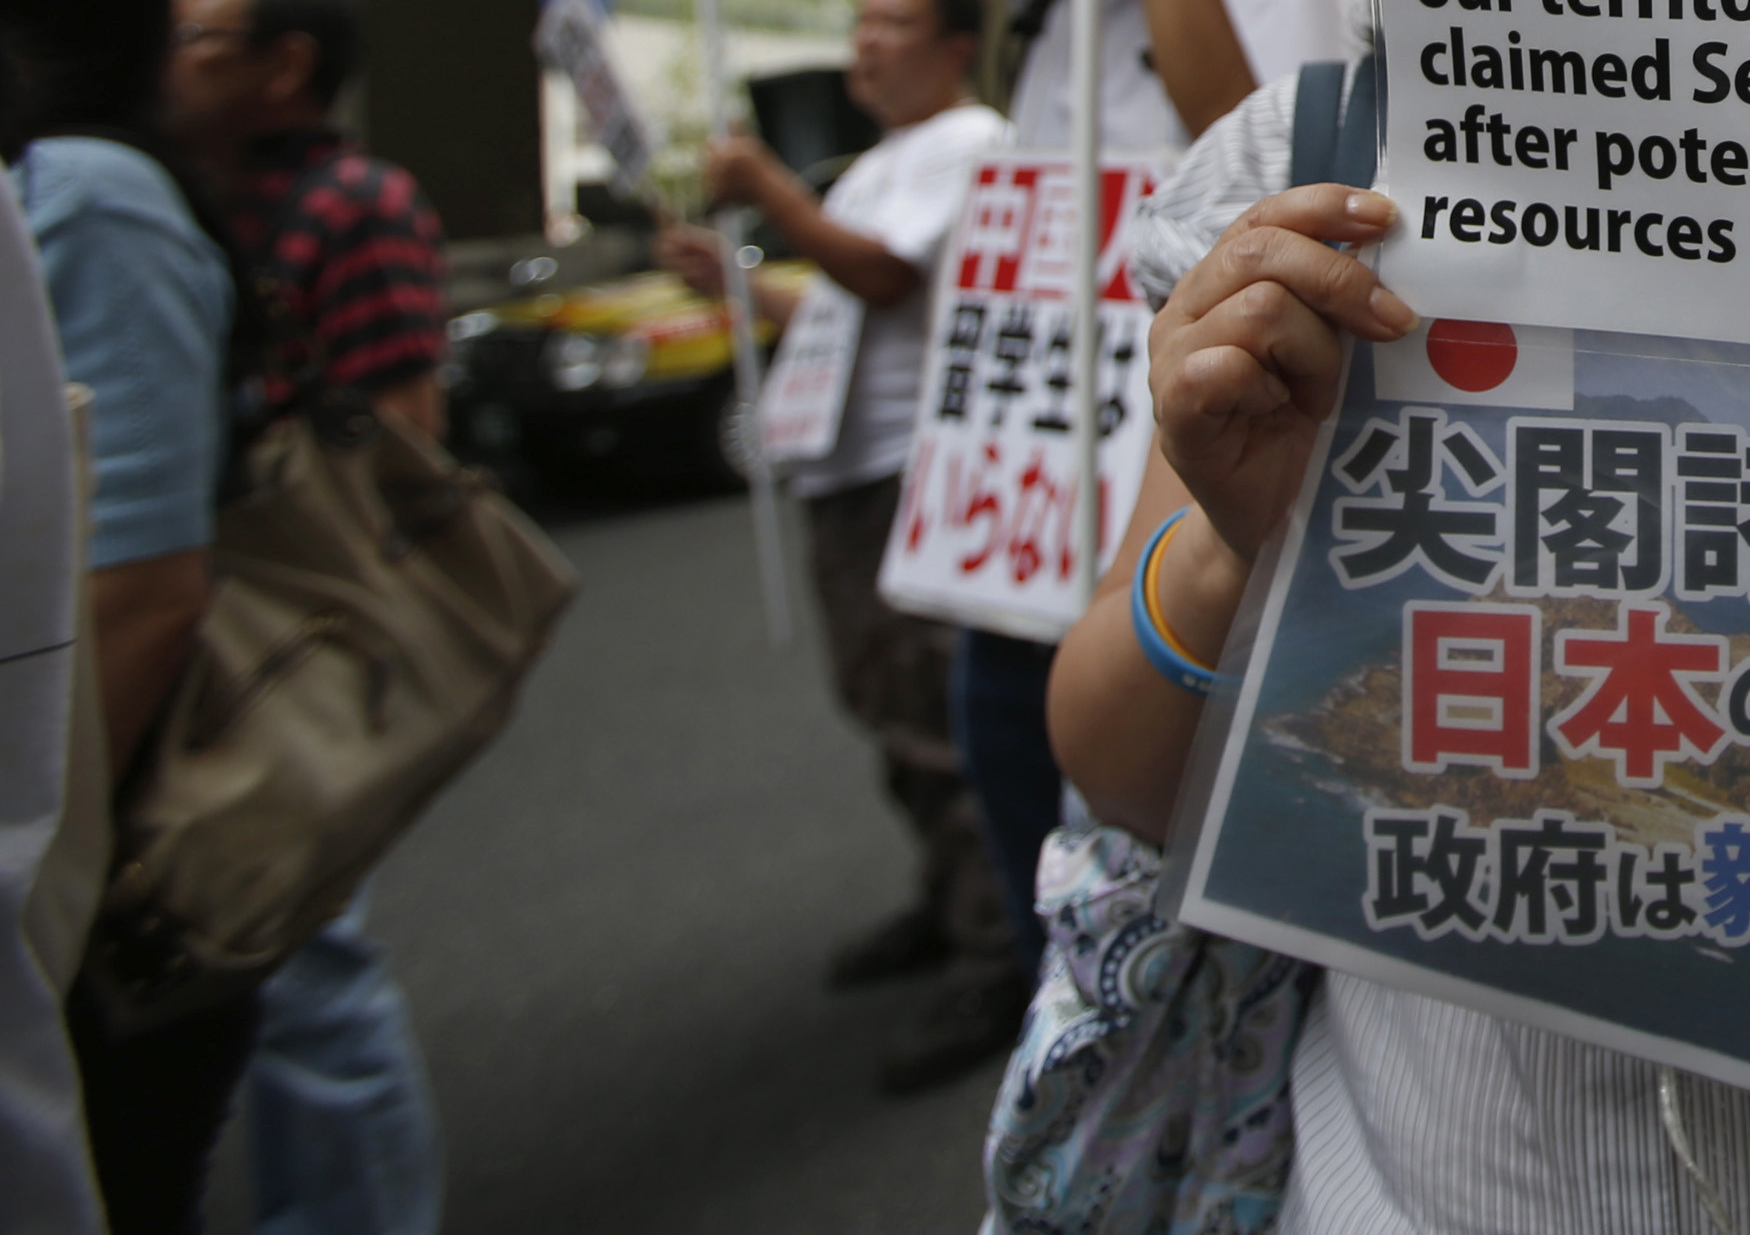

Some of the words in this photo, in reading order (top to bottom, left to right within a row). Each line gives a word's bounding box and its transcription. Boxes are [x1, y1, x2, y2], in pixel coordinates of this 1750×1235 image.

[1420, 27, 1672, 102] claimed
[1422, 104, 1578, 172] after
[1421, 193, 1736, 264] resources
